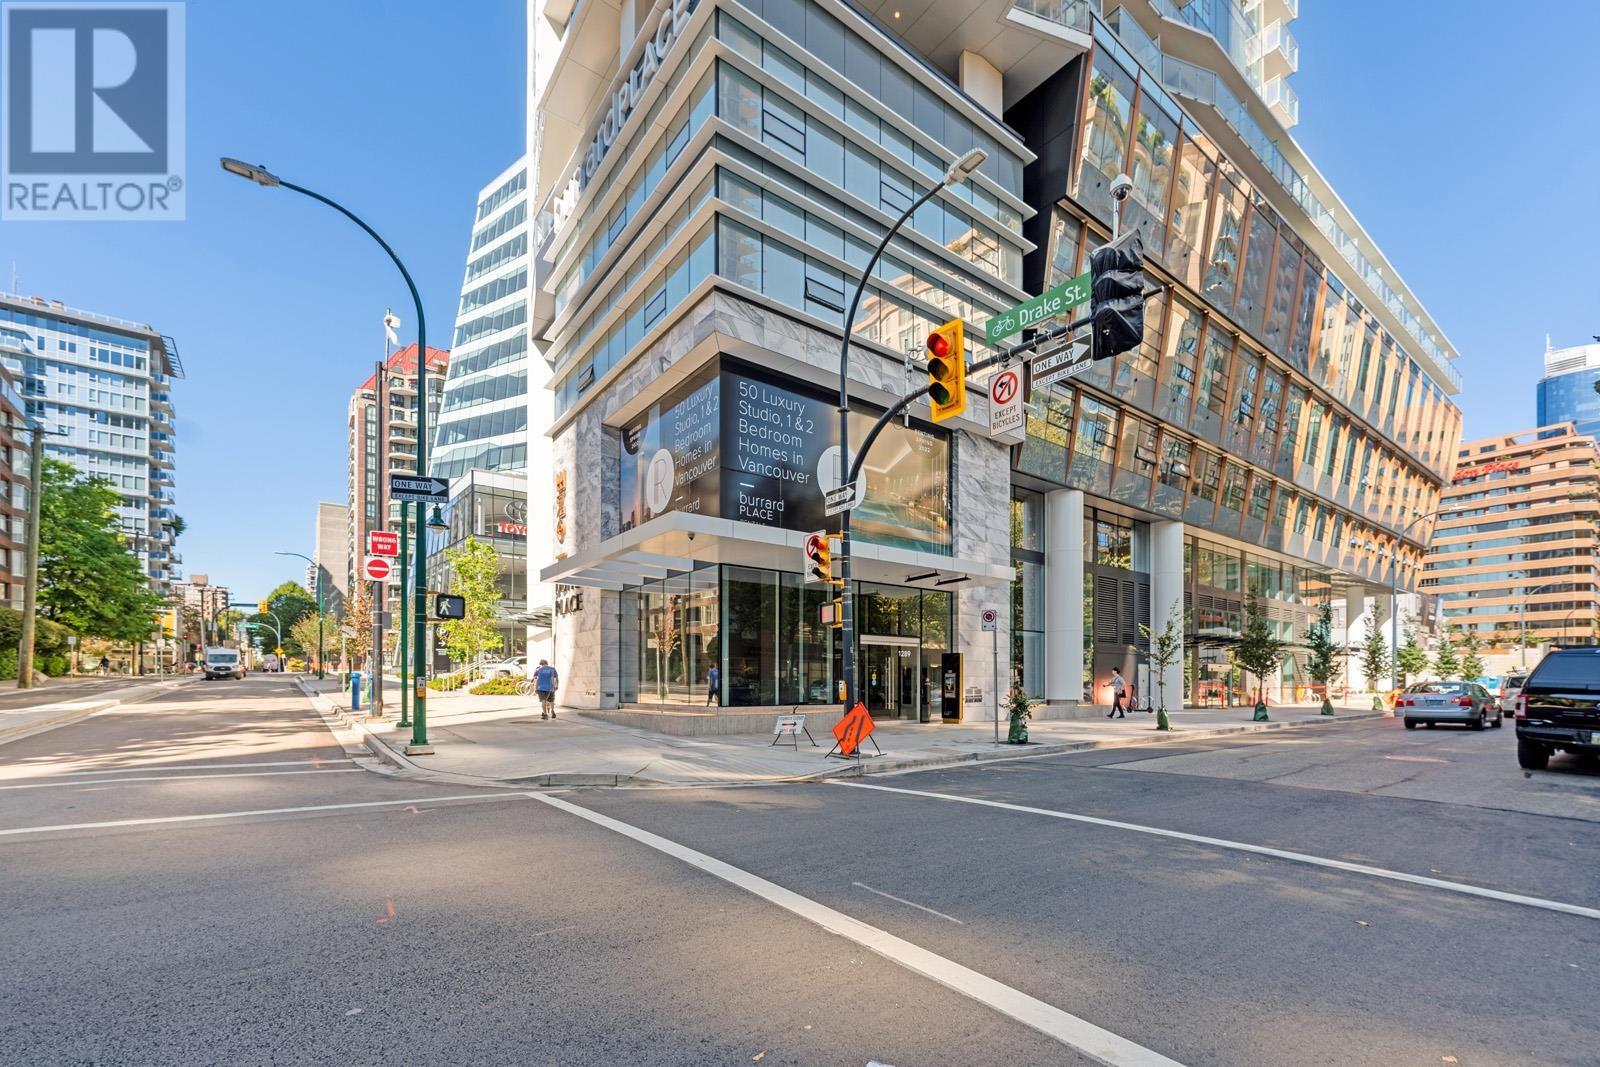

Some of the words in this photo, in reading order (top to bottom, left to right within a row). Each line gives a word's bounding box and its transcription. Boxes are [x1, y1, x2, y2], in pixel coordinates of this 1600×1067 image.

[1019, 297, 1061, 326] Drake
[1065, 284, 1087, 305] St.
[1034, 358, 1052, 372] ONE
[1055, 349, 1074, 364] WAY
[1035, 374, 1055, 386] EXCEPT
[1057, 368, 1070, 378] BIKE
[1072, 361, 1087, 372] LANE
[674, 401, 685, 419] 50
[686, 383, 714, 411] Luxury
[739, 381, 758, 400] 50
[762, 388, 805, 416] Luxury
[994, 405, 1017, 420] EXCEPT
[674, 413, 700, 436] Studio,
[738, 400, 784, 428] Studio,
[992, 413, 1020, 430] BICYCLES
[675, 422, 712, 453] Bedroom
[739, 418, 802, 448] Bedroom
[675, 446, 702, 469] Homes
[704, 439, 713, 453] in
[739, 436, 788, 462] Homes
[793, 451, 804, 466] in
[675, 455, 717, 486] Vancouver
[738, 455, 810, 484] Vancouver
[394, 480, 412, 488] ONE
[415, 482, 433, 490] WAY
[739, 491, 785, 512] burrard
[739, 505, 774, 521] PLACE
